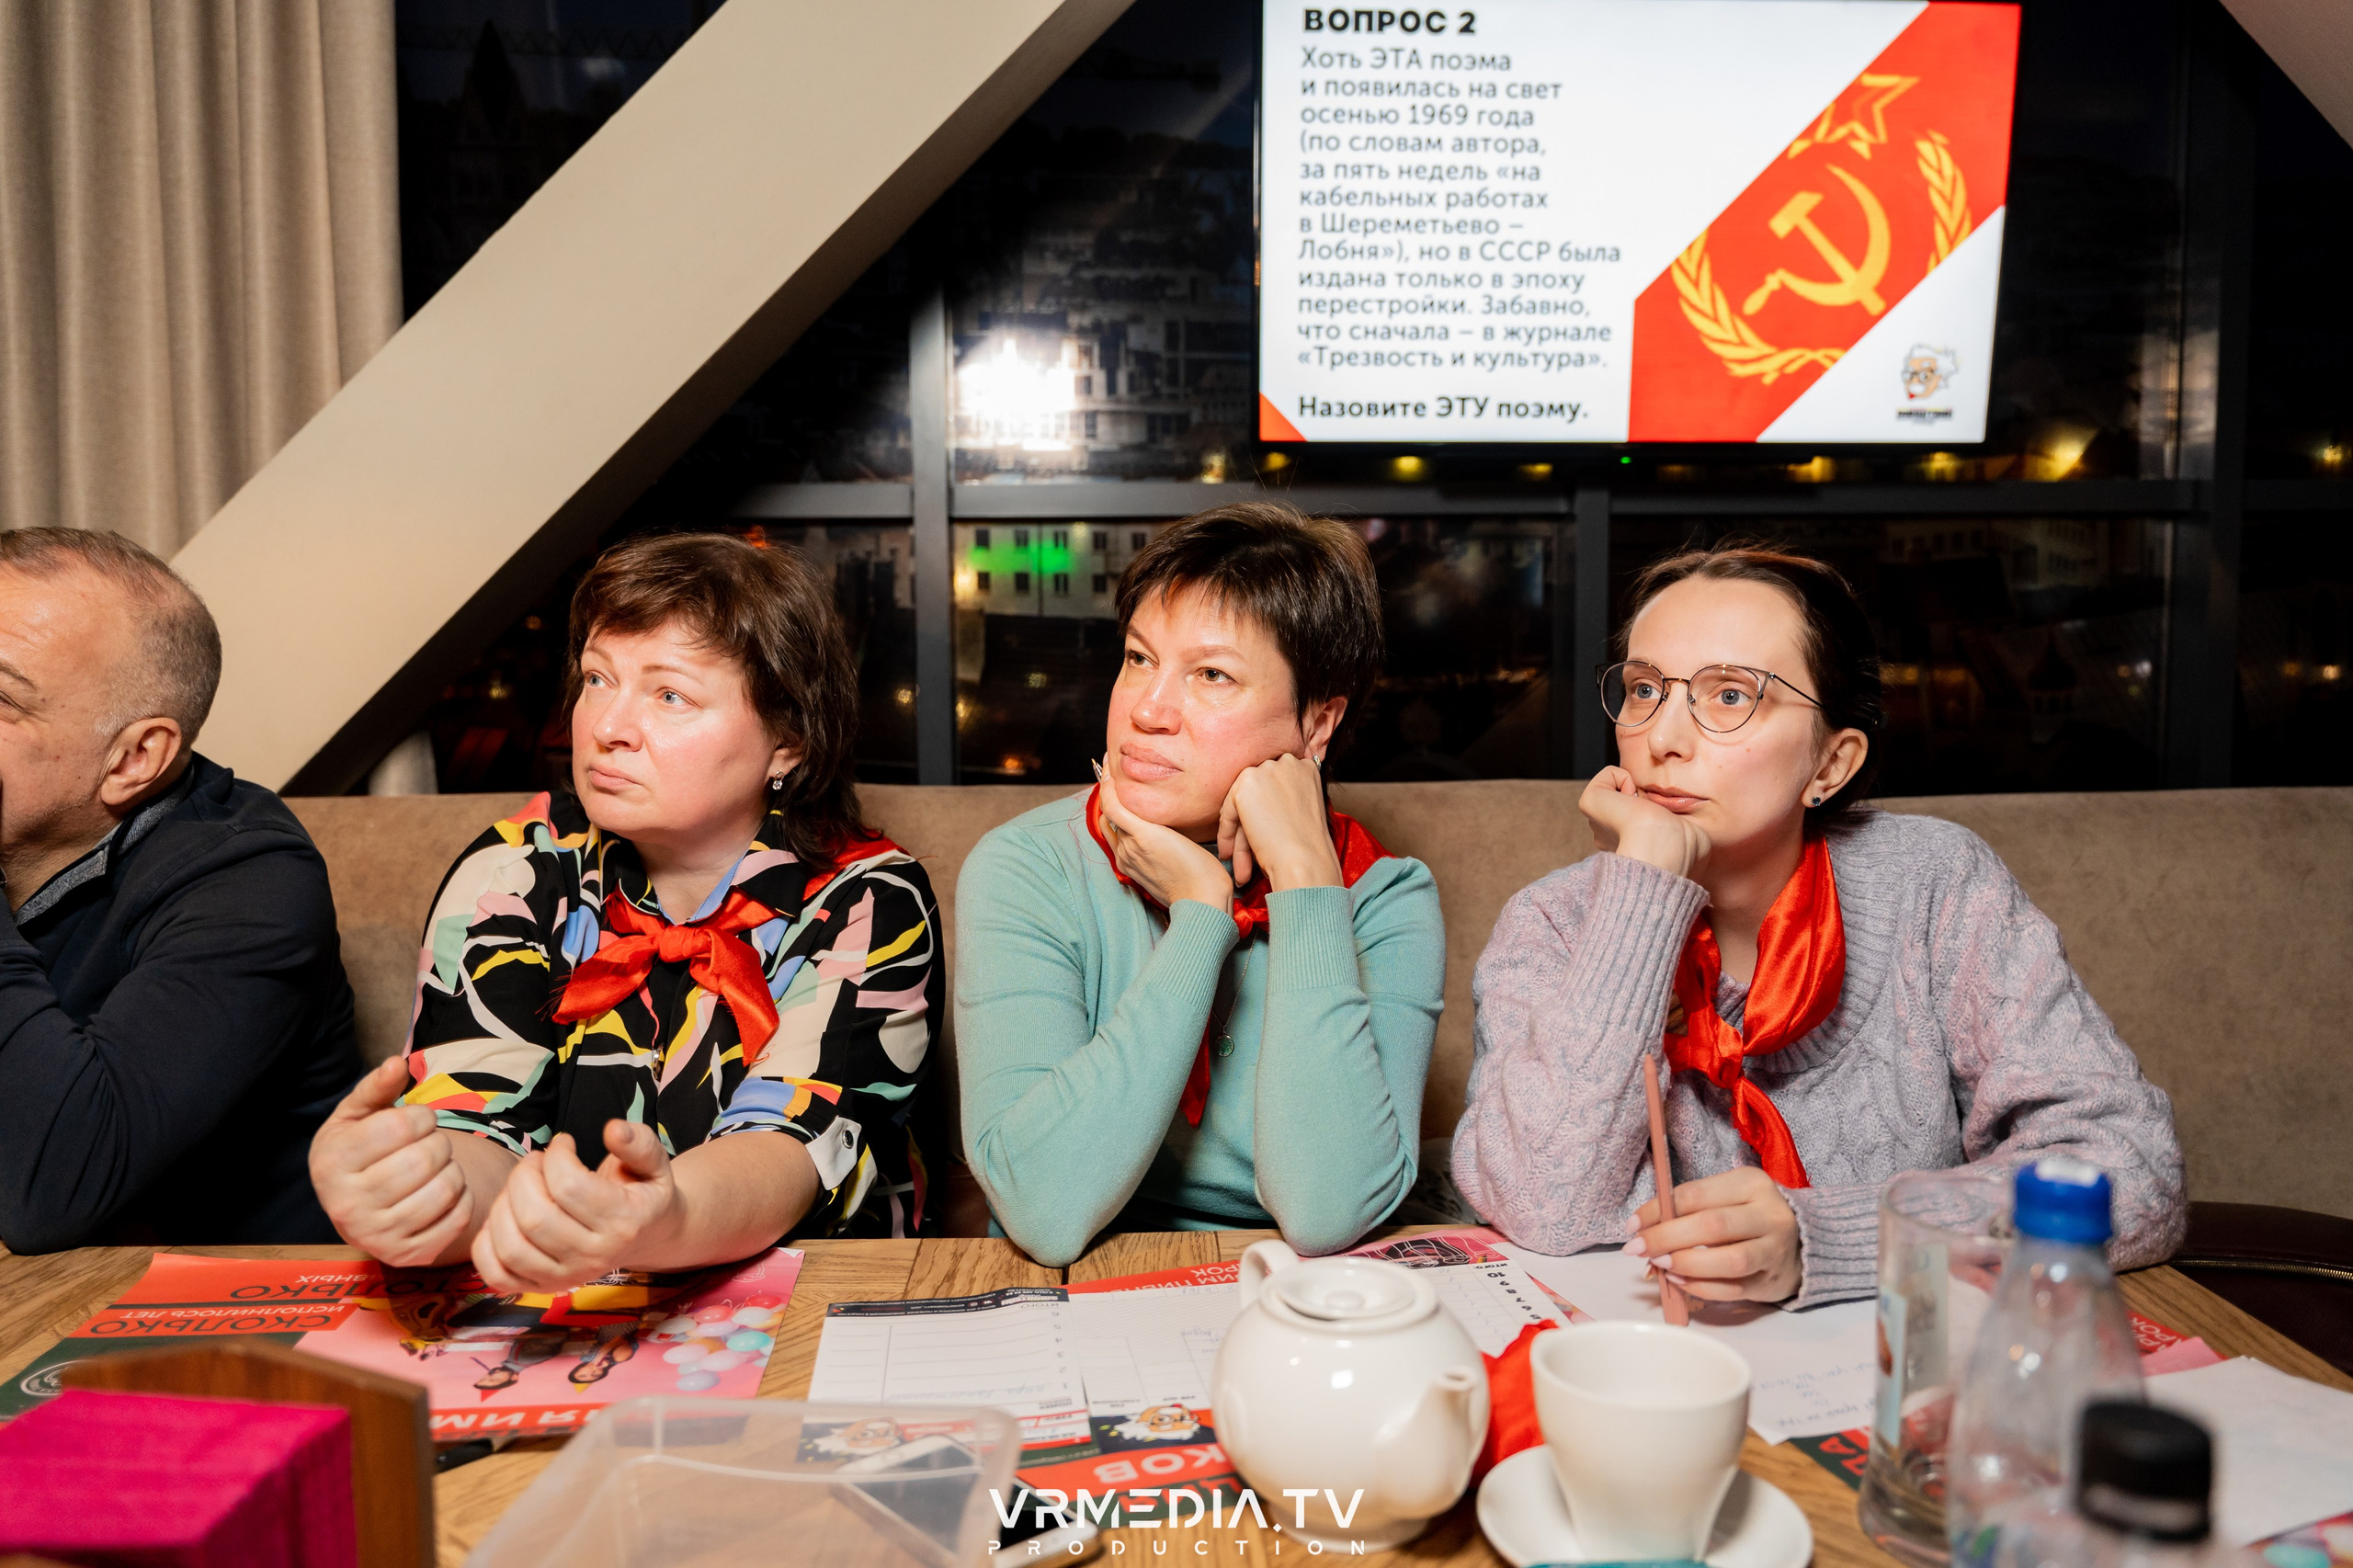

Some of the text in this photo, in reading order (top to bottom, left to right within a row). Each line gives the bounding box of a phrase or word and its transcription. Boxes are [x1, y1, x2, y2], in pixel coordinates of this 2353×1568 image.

[1304, 9, 1476, 33] ВОПРОС 2
[1302, 47, 1512, 71] Хоть ЭТА поэма
[1302, 80, 1562, 99] и появилась на свет
[1301, 105, 1535, 128] осенью 1969 года
[1301, 130, 1546, 157] (по словам автора,
[1301, 163, 1540, 183] за пять недель «на
[1301, 187, 1548, 211] кабельных работах
[1301, 219, 1312, 233] в
[1322, 214, 1500, 238] Шереметьево
[1298, 239, 1620, 263] Лобня»), но в СССР была
[1299, 272, 1585, 293] издана только в эпоху
[1298, 295, 1590, 319] перестройки. Забавно,
[1298, 325, 1340, 341] что
[1349, 325, 1449, 341] сначала
[1483, 325, 1495, 341] в
[1504, 325, 1611, 347] журнале
[1298, 347, 1608, 372] «Трезвость и культура».
[1300, 397, 1588, 423] Назовите ЭТУ поэму.
[230, 1279, 485, 1299] СТОЛЬКО
[119, 1305, 345, 1319] ИСПОЛНИЛОСЬ ЛЕТ
[90, 1315, 332, 1335] СКОЛЬКО
